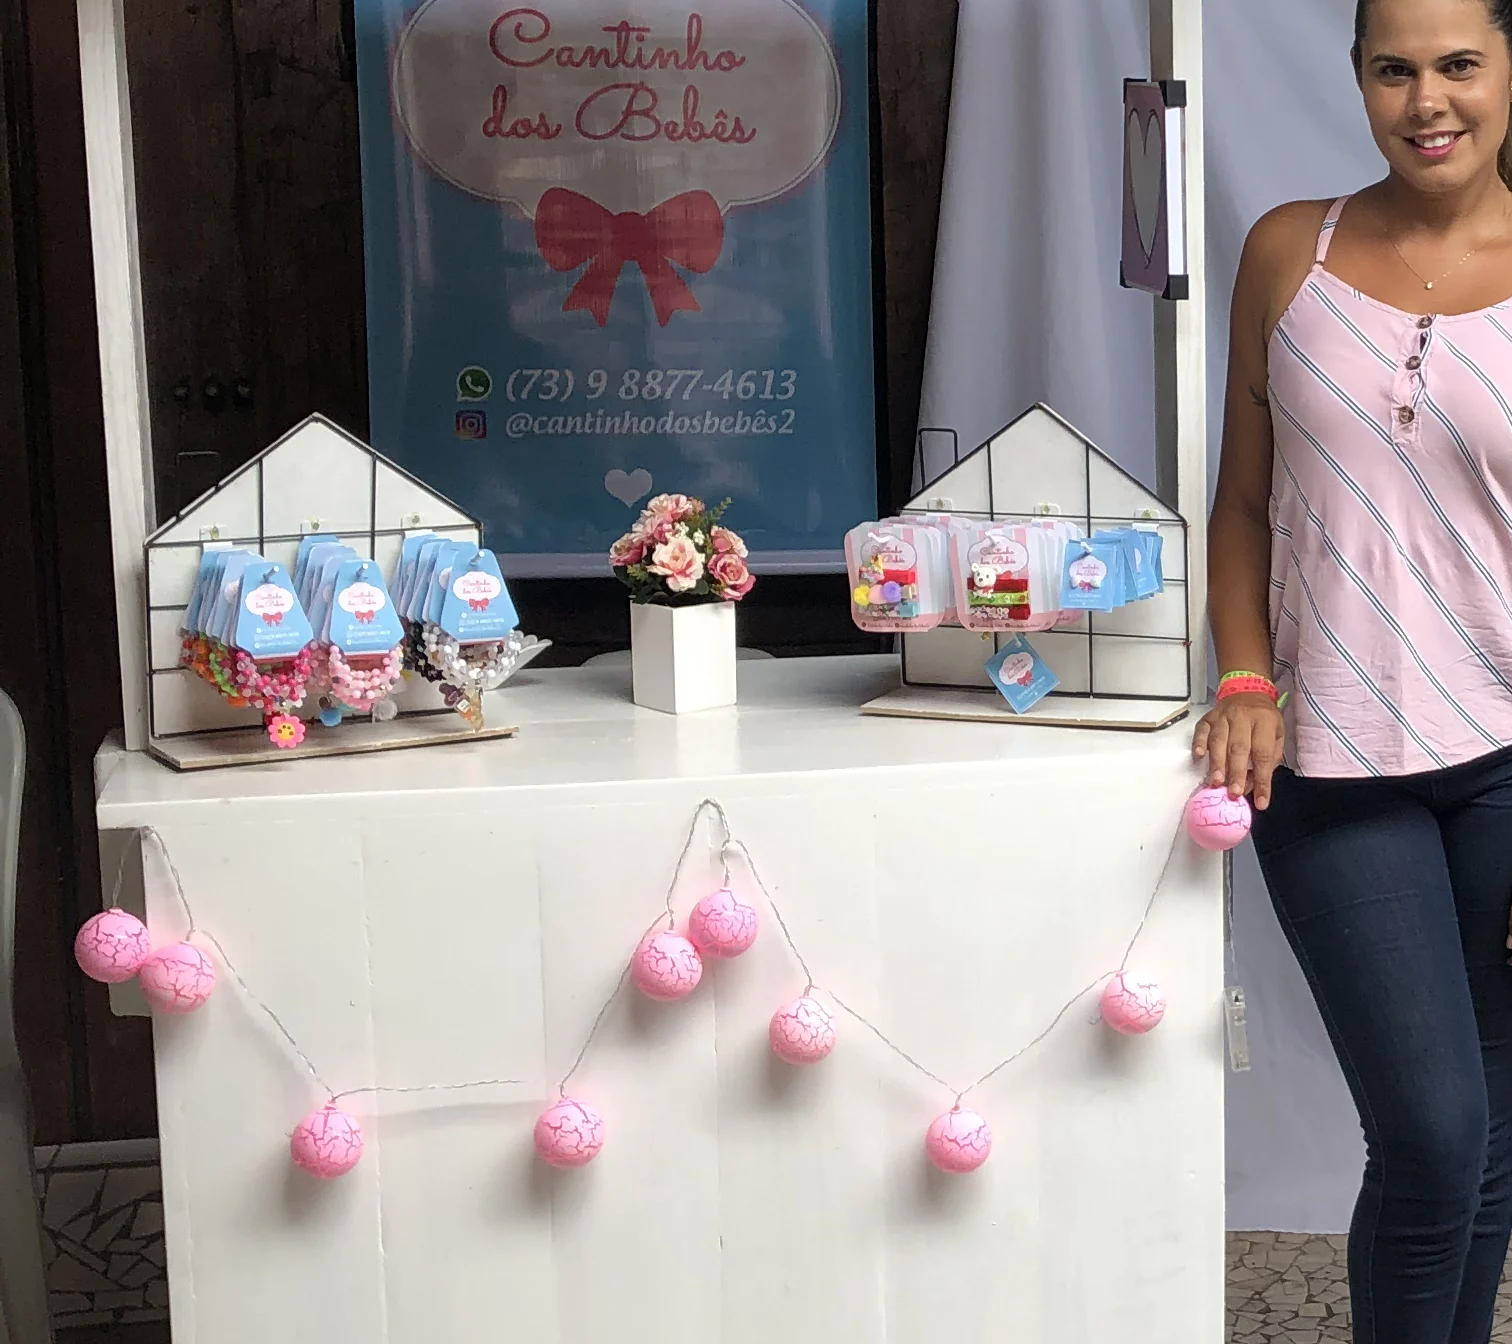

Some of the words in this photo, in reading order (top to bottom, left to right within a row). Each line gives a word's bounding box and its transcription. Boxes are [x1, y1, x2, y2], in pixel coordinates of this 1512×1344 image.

[488, 7, 746, 72] Cantinho
[481, 83, 562, 140] dos
[574, 80, 757, 144] Bebês
[505, 367, 575, 403] (73)
[586, 368, 608, 401] 9
[617, 367, 798, 401] 8877-4613
[506, 408, 797, 439] @cantinhodosbebês2
